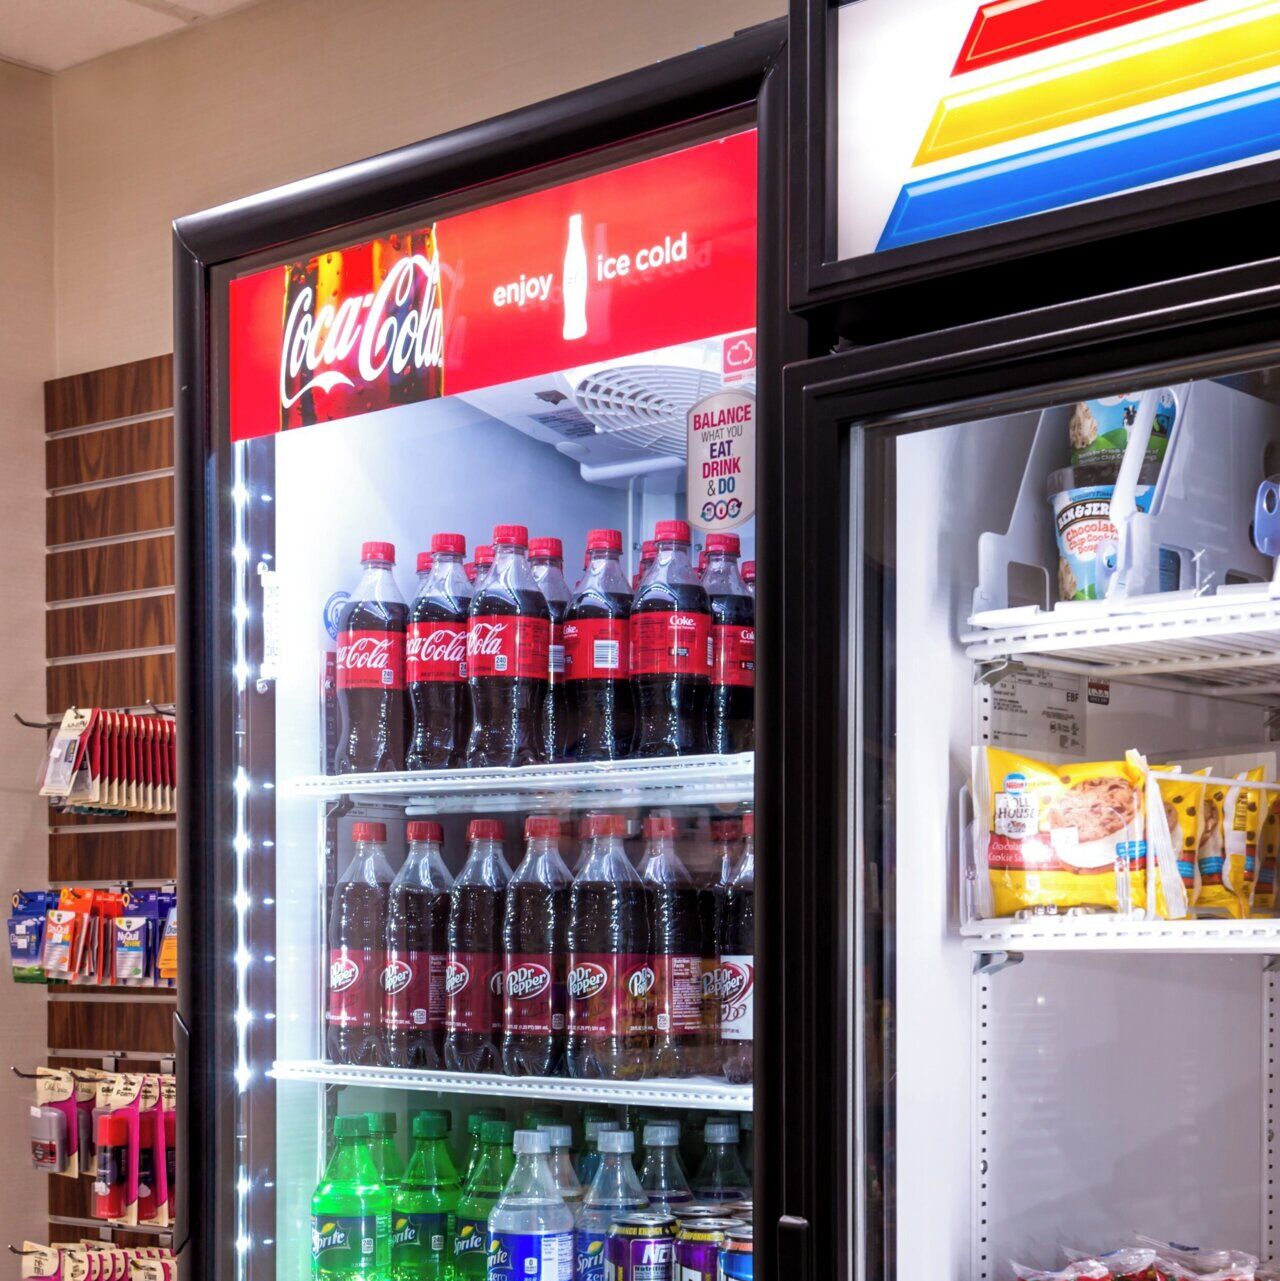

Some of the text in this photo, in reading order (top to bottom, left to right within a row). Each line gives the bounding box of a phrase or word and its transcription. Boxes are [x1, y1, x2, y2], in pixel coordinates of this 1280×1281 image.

[493, 232, 688, 307] enjoy ice cold
[280, 254, 442, 408] Coca-Cola
[693, 405, 751, 431] BALANCE
[701, 425, 743, 442] WHAT YOU
[709, 440, 733, 459] EAT
[702, 457, 741, 479] DRINK
[707, 476, 735, 496] & DO
[669, 615, 694, 626] Coke
[507, 970, 547, 996] Pepper
[514, 967, 535, 983] Dr
[567, 970, 603, 996] Pepper
[576, 966, 592, 981] Dr
